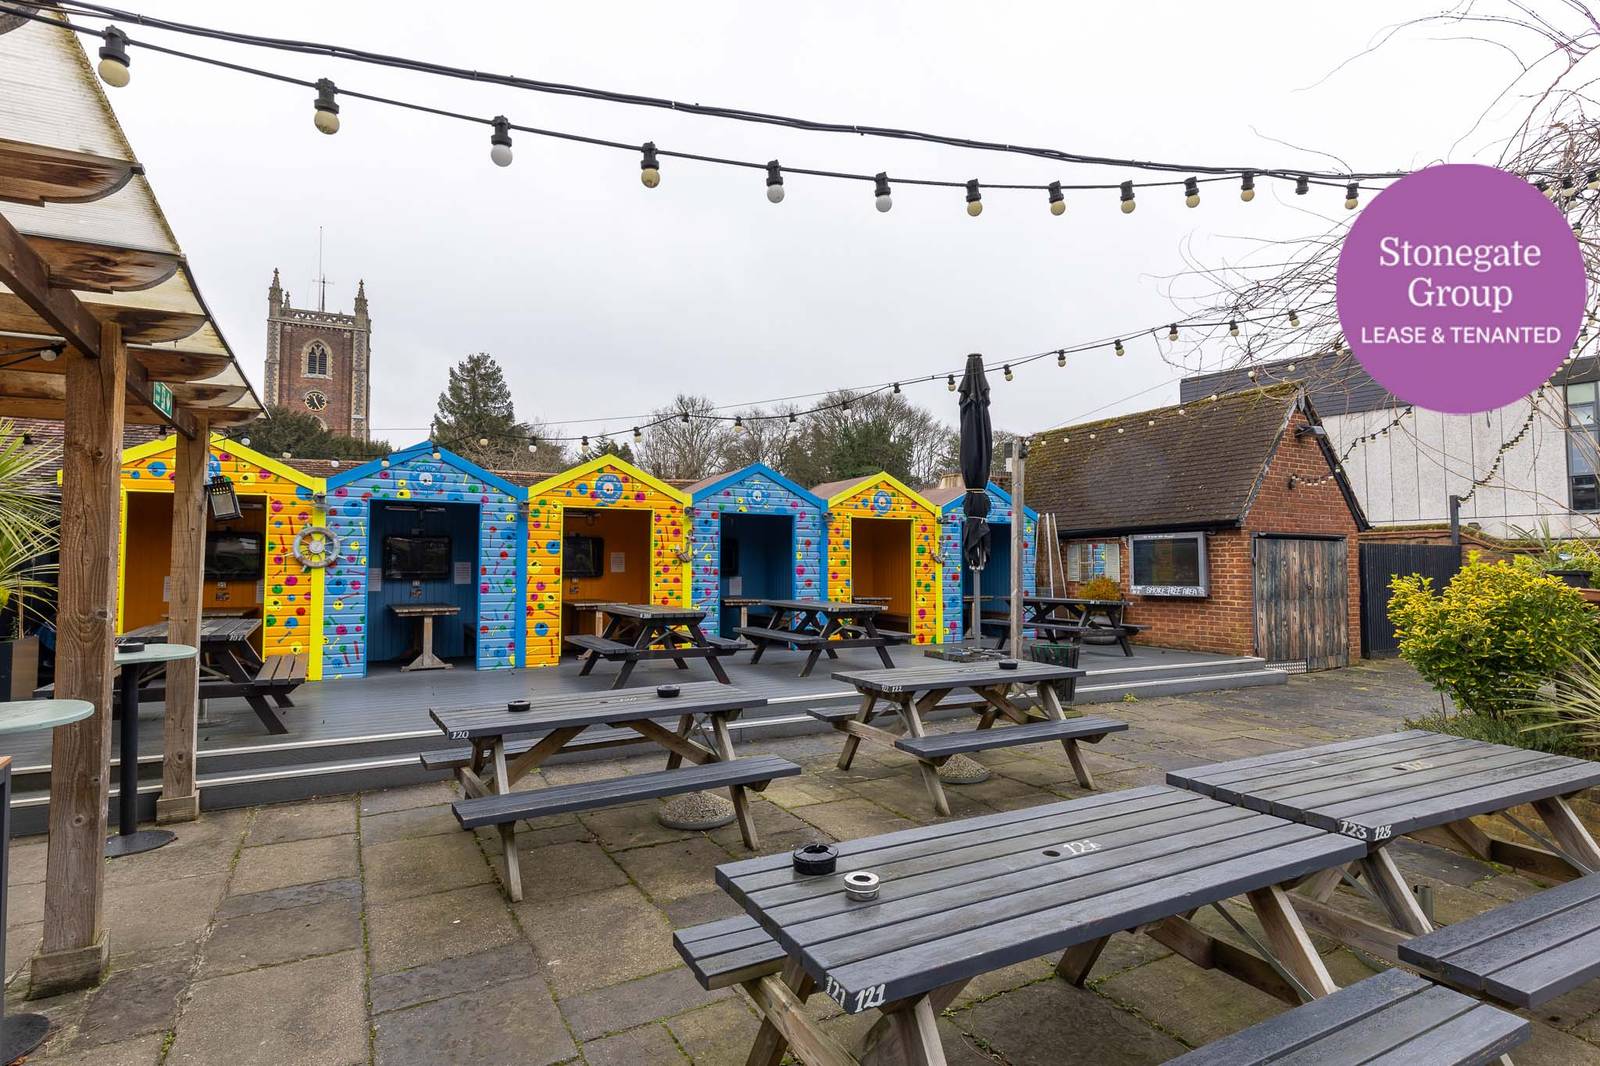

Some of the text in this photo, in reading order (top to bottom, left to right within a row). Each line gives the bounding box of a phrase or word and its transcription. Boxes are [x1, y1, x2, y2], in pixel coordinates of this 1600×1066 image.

[451, 730, 470, 740] 120
[1339, 820, 1368, 840] 123
[854, 983, 887, 1013] 121
